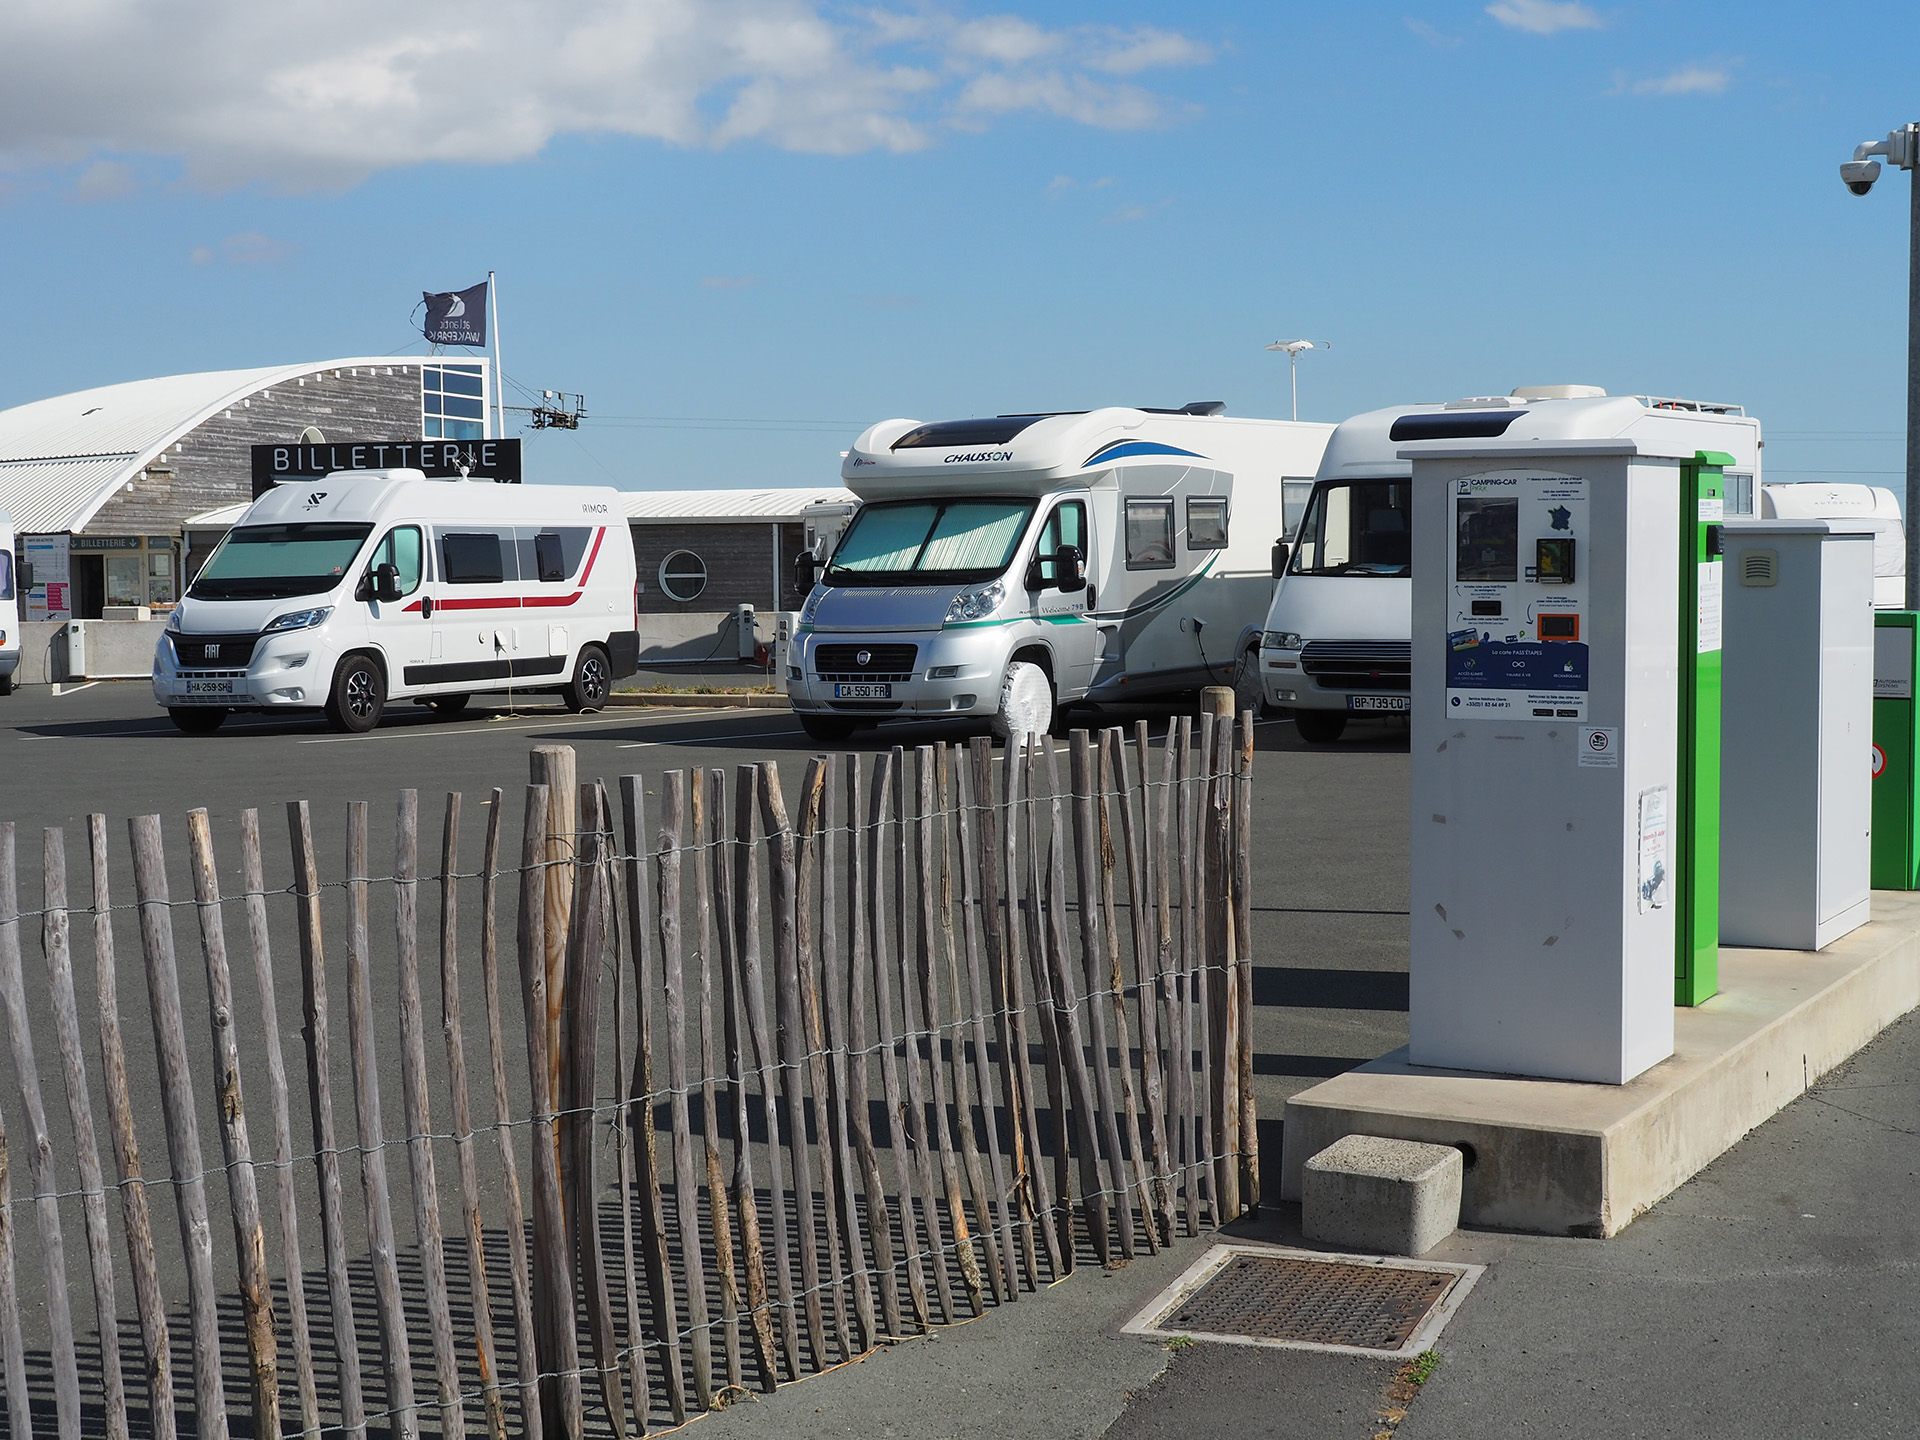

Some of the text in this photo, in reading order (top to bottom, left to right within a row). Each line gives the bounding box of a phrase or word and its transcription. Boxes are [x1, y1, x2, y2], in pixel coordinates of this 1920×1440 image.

[273, 443, 497, 471] BILLETTERIE
[944, 452, 1013, 464] CHAUSSON
[582, 504, 608, 513] RIMOR
[81, 539, 126, 548] BILLETTERIE
[1042, 606, 1070, 614] Welcome
[205, 644, 221, 659] FIAT
